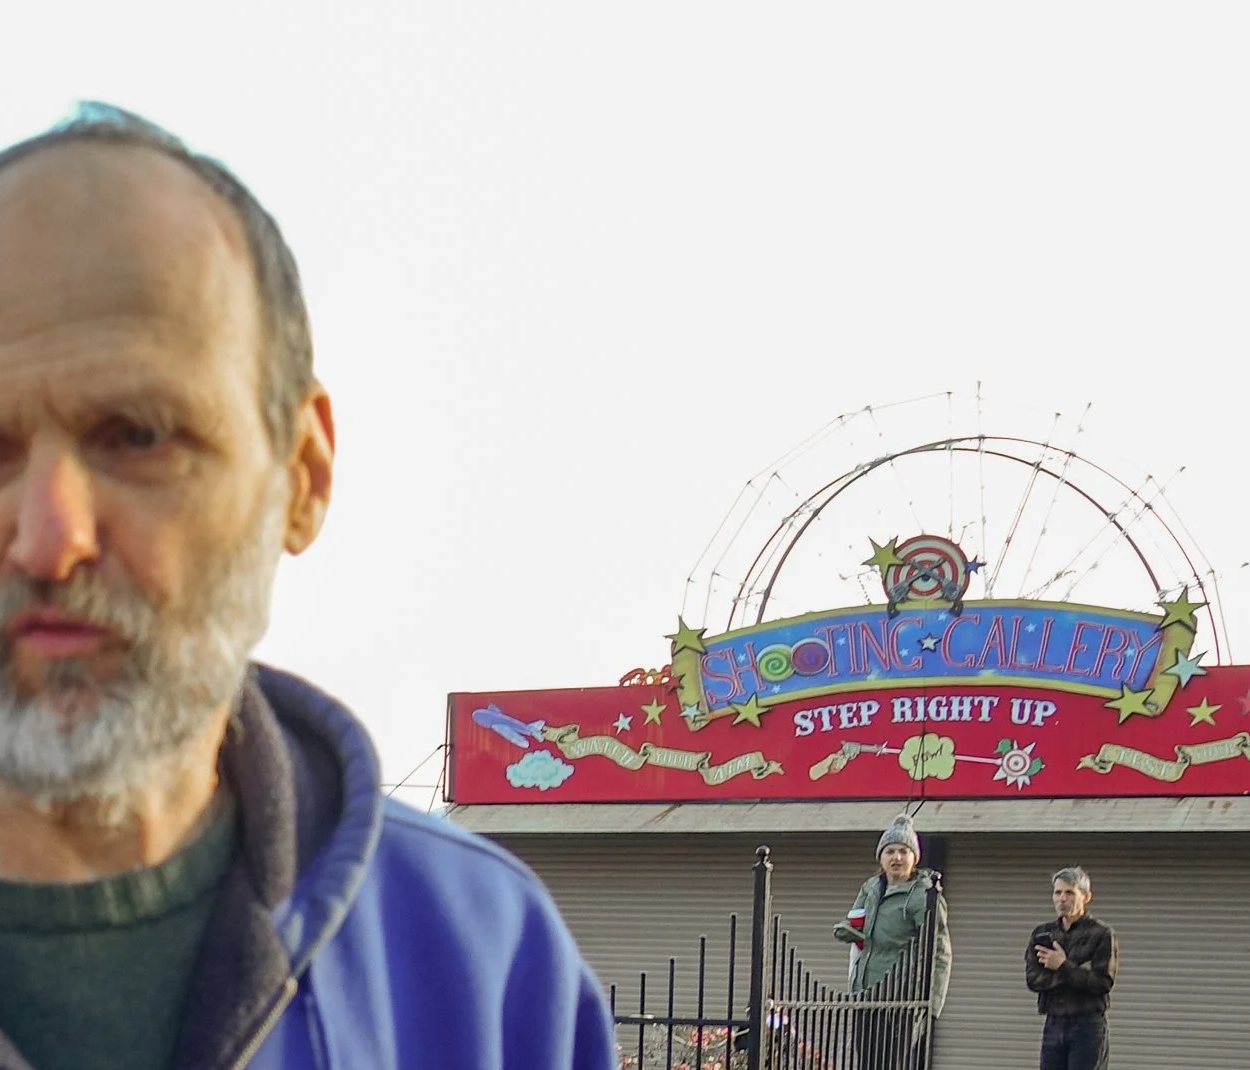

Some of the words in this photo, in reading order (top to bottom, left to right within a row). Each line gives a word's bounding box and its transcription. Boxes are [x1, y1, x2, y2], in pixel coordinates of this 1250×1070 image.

[701, 616, 923, 704] SHOOTING
[941, 614, 1163, 684] GALLERY
[793, 700, 881, 737] STEP
[891, 696, 999, 723] RIGHT
[1011, 698, 1057, 726] UP
